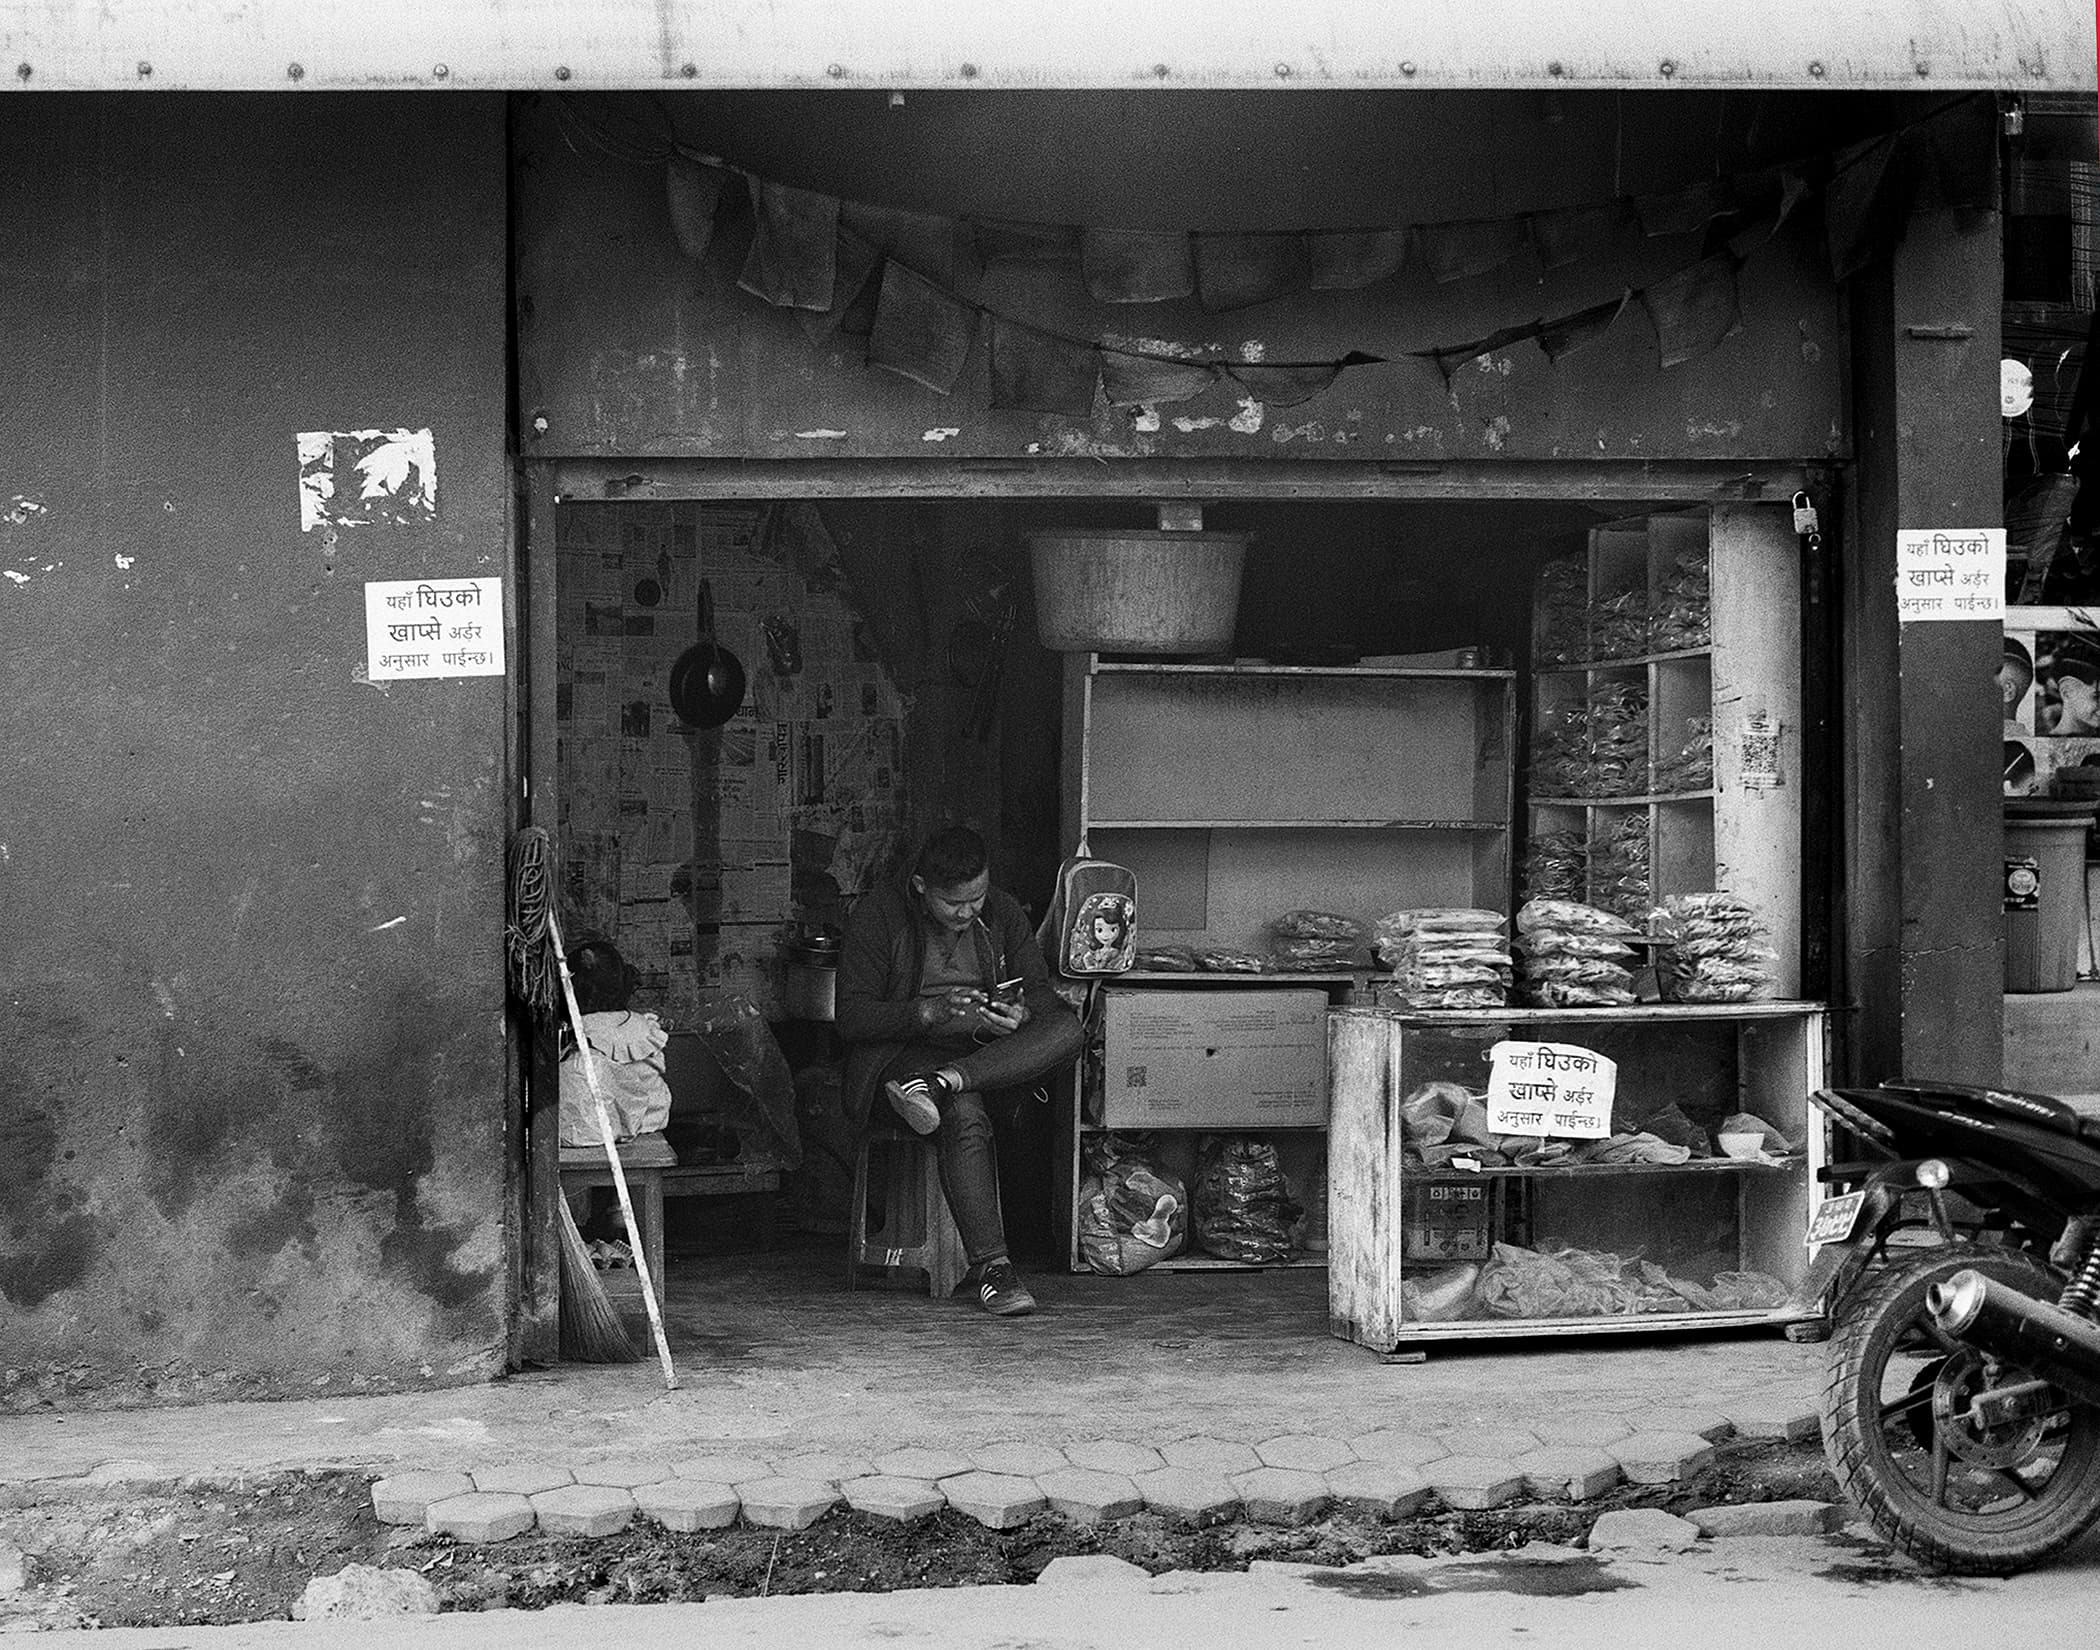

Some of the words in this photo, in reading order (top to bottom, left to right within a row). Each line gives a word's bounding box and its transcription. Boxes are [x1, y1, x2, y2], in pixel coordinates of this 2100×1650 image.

[1906, 539, 1930, 557] यहाँ
[1933, 532, 1989, 555] घिउको
[1907, 563, 1954, 586] खाप्से
[1961, 569, 1990, 588] अर्डर
[386, 592, 412, 610] यहाँ
[416, 582, 482, 608] घिउको
[1900, 598, 1943, 614] अनुसार
[388, 616, 442, 642] खाप्से
[449, 622, 482, 641] अर्डर
[379, 654, 430, 672] अनुसार
[1509, 1052, 1533, 1070] यहाँ
[1537, 1047, 1598, 1073] घिउको
[1508, 1078, 1558, 1101] खाप्से
[1563, 1087, 1595, 1106] अर्डर
[1497, 1111, 1543, 1128] अनुसार
